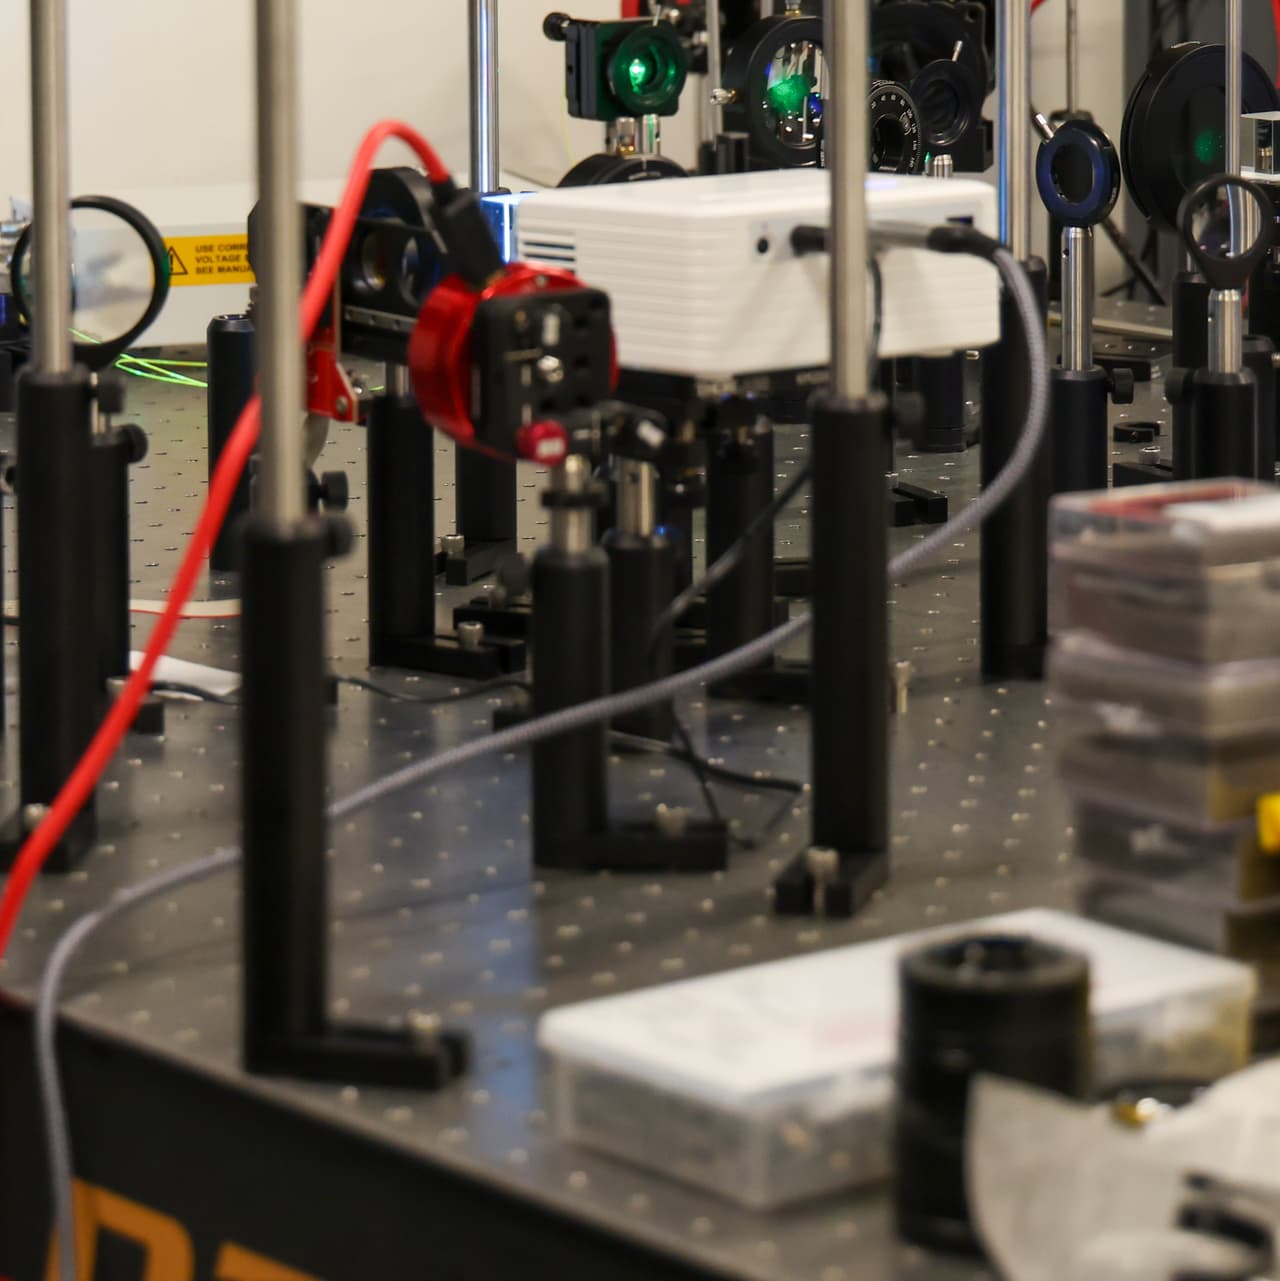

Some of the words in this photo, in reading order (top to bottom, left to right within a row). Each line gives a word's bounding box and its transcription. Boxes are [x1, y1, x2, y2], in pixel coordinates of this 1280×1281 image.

[195, 244, 214, 253] USE
[217, 243, 247, 252] CORR
[195, 254, 241, 263] VOLTAGE
[217, 264, 251, 273] MANUA
